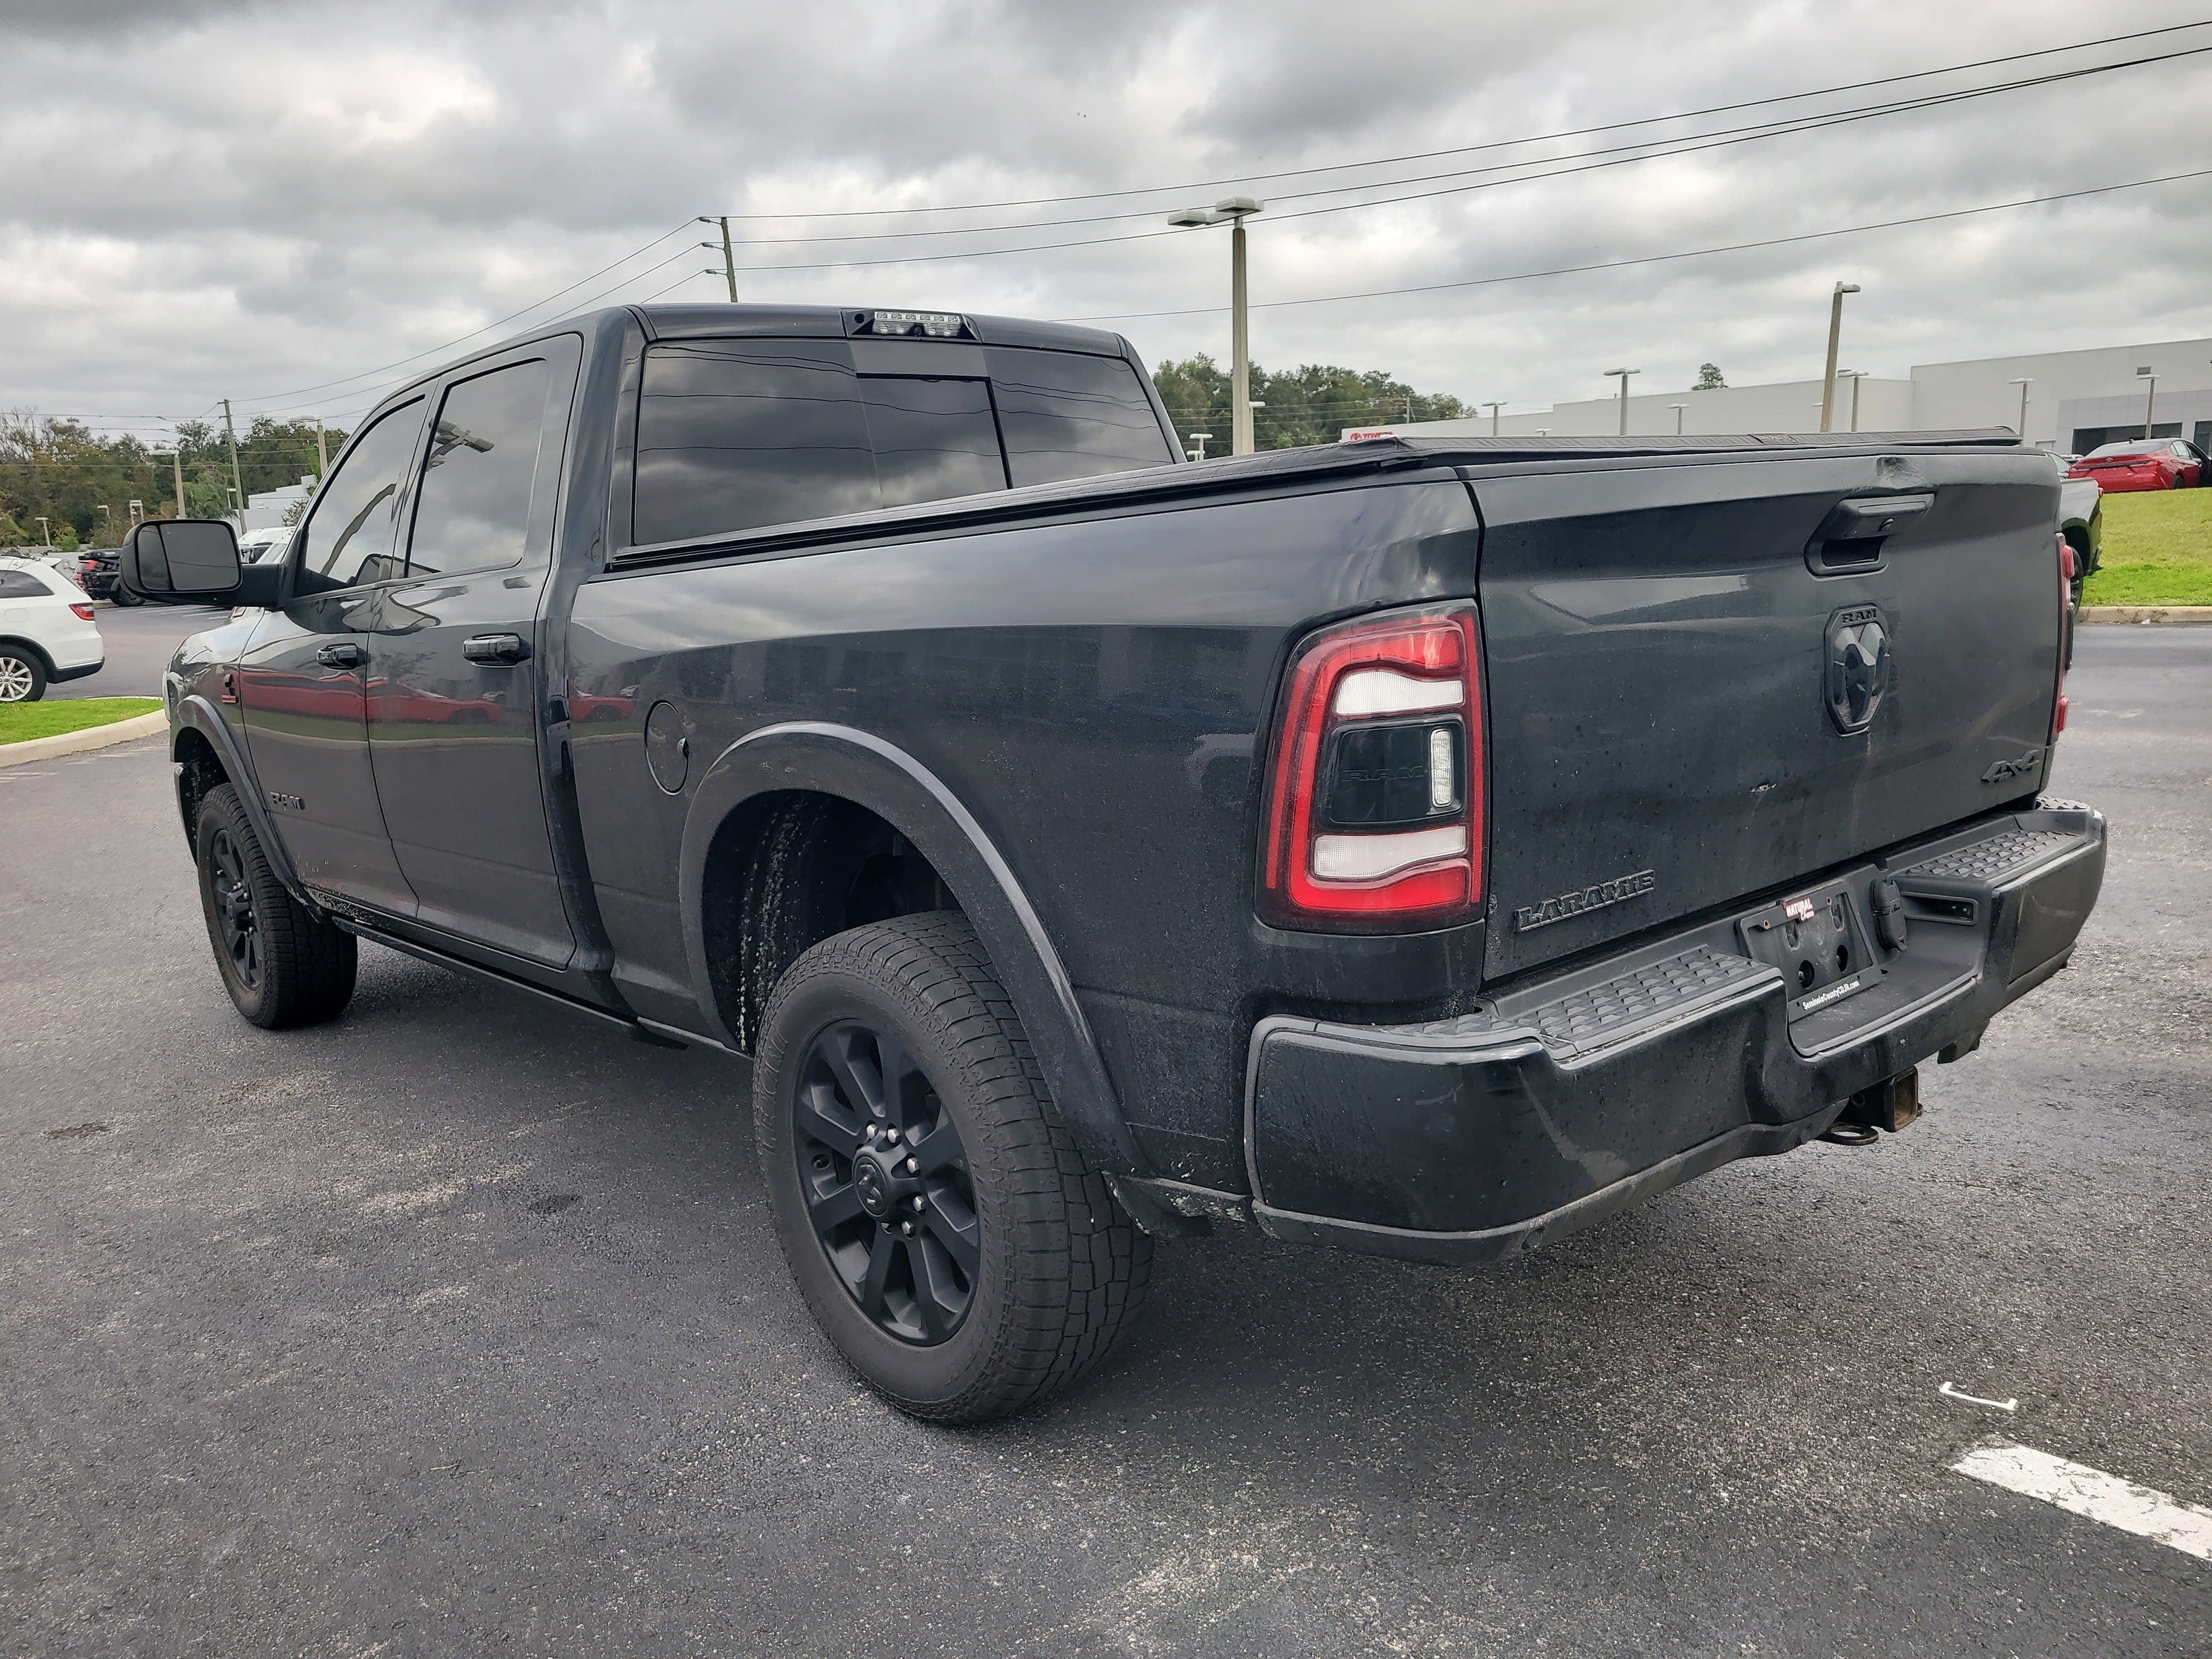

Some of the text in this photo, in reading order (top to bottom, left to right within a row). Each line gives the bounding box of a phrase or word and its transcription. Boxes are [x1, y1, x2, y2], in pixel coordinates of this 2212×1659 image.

[1842, 609, 1877, 624] RAM
[1342, 765, 1424, 781] RAM
[1514, 870, 1655, 932] LARAMIE
[1786, 896, 1813, 918] NATURAL
[1802, 980, 1860, 1011] SeminoleCountyCDJR.com
